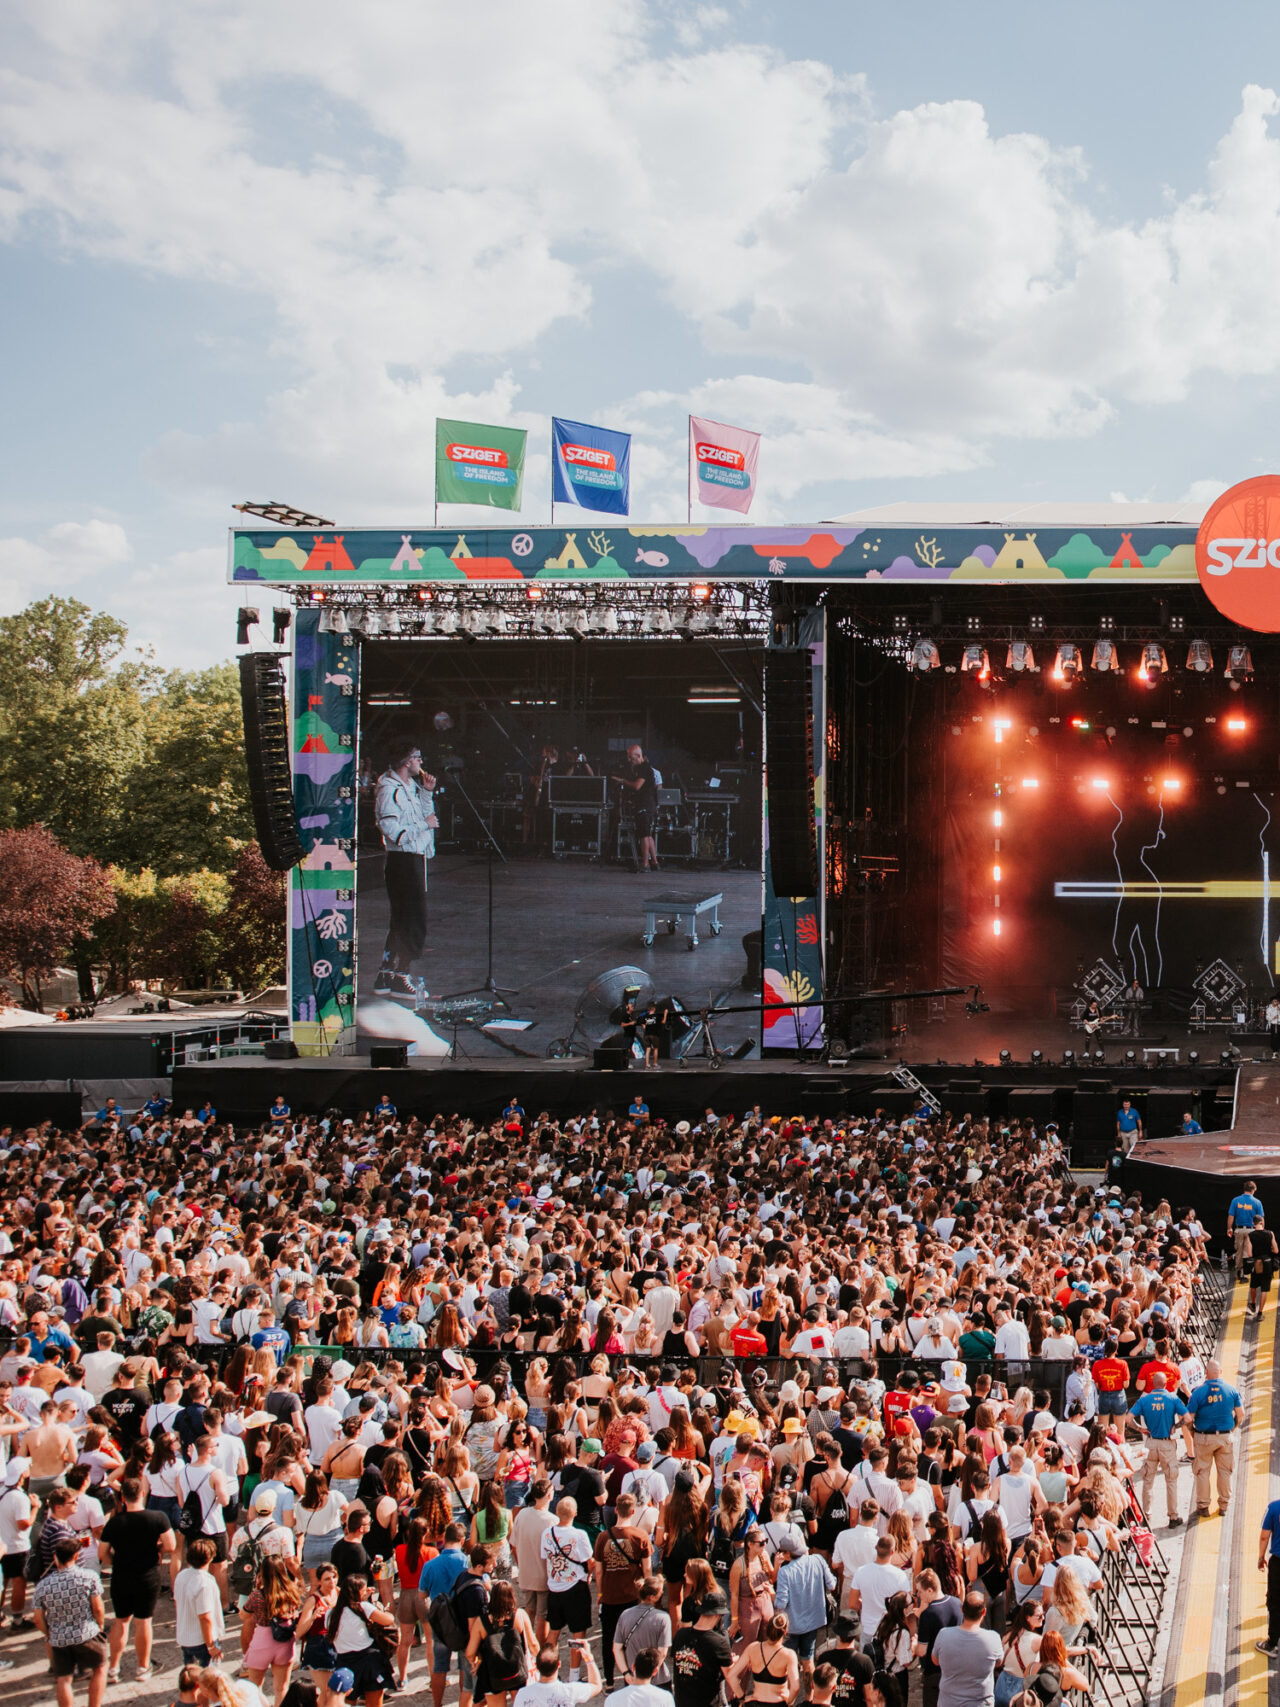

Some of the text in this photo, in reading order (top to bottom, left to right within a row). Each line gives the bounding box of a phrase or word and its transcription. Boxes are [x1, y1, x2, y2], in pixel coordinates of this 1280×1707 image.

[479, 468, 505, 477] ISLAND
[576, 467, 614, 480] THE ISLAND
[475, 473, 509, 483] FREEDOM
[585, 475, 616, 487] FREEDOM
[715, 474, 744, 486] FREEDOM
[1207, 1395, 1223, 1403] 961
[1152, 1403, 1165, 1411] 761
